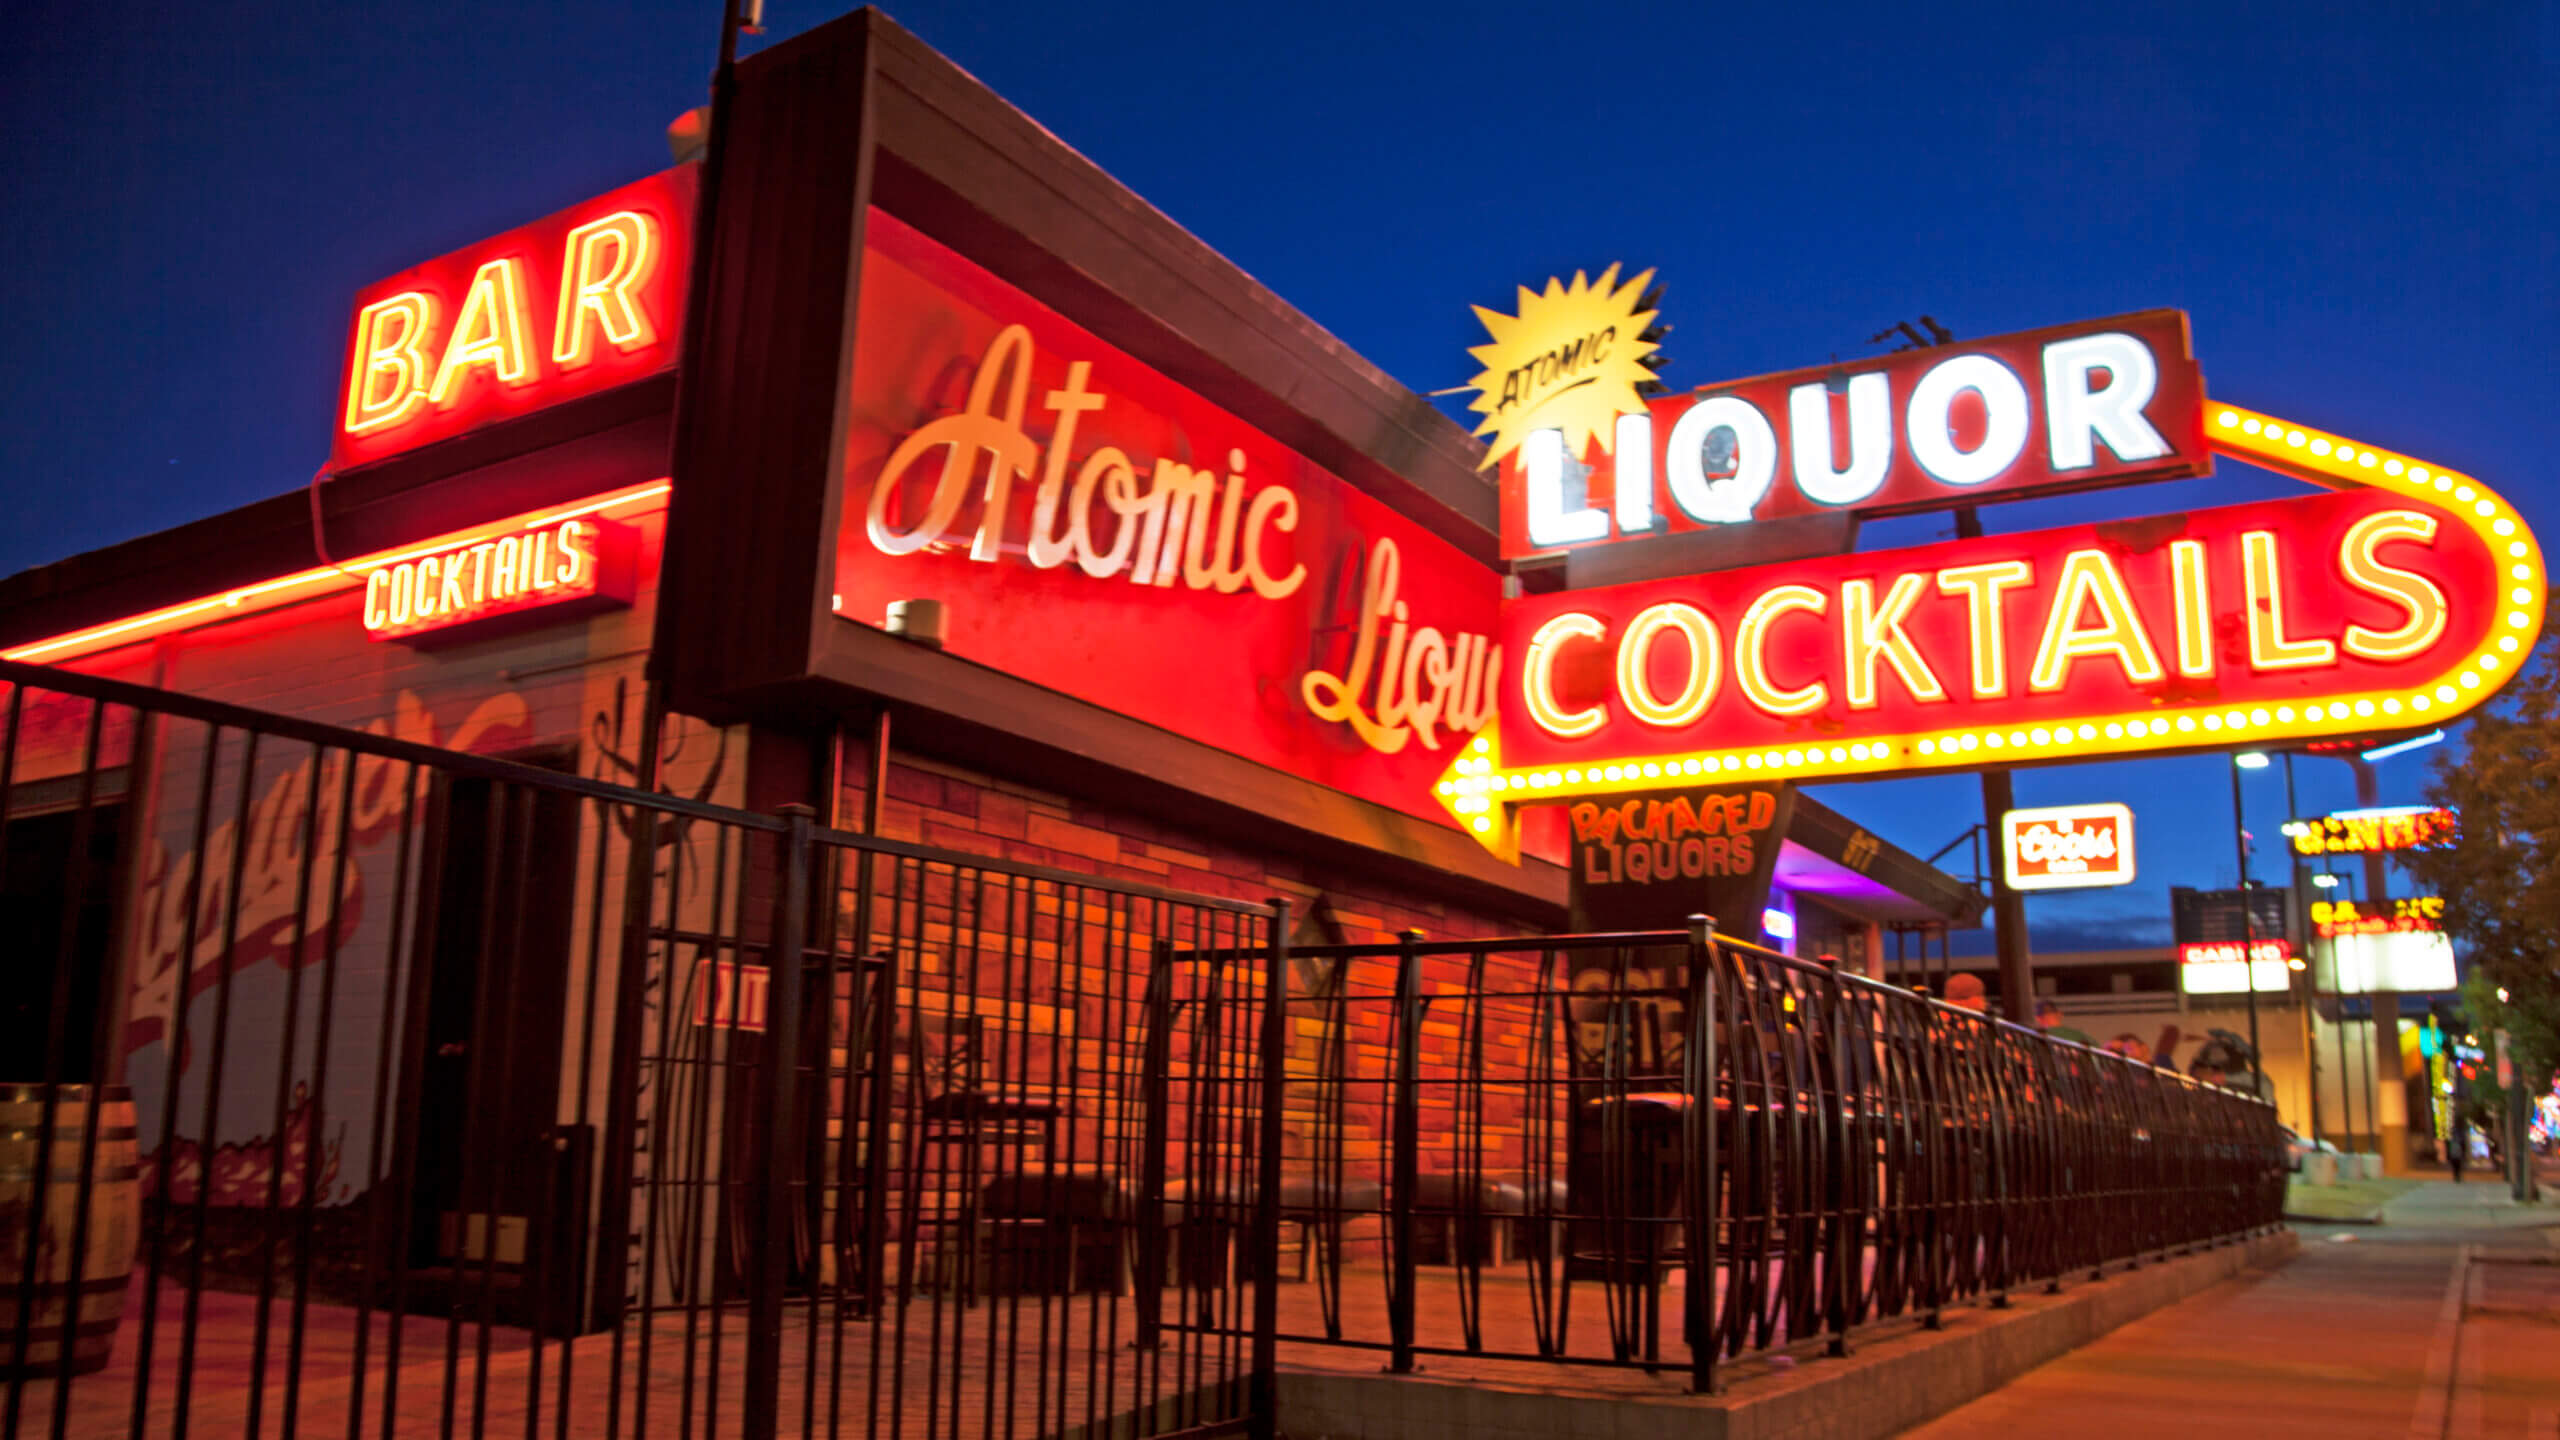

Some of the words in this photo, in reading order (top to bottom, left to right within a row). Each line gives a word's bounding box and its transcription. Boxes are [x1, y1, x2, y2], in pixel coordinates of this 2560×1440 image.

[345, 210, 656, 434] BAR
[1496, 325, 1616, 412] ATOMIC
[866, 323, 1306, 600] Atomic
[1527, 330, 2178, 547] LIQUOR
[364, 520, 583, 631] COCKTAILS
[1523, 510, 2448, 738] COCKTAILS
[1570, 790, 1776, 849] PACKAGED
[1585, 834, 1755, 884] LIQUORS
